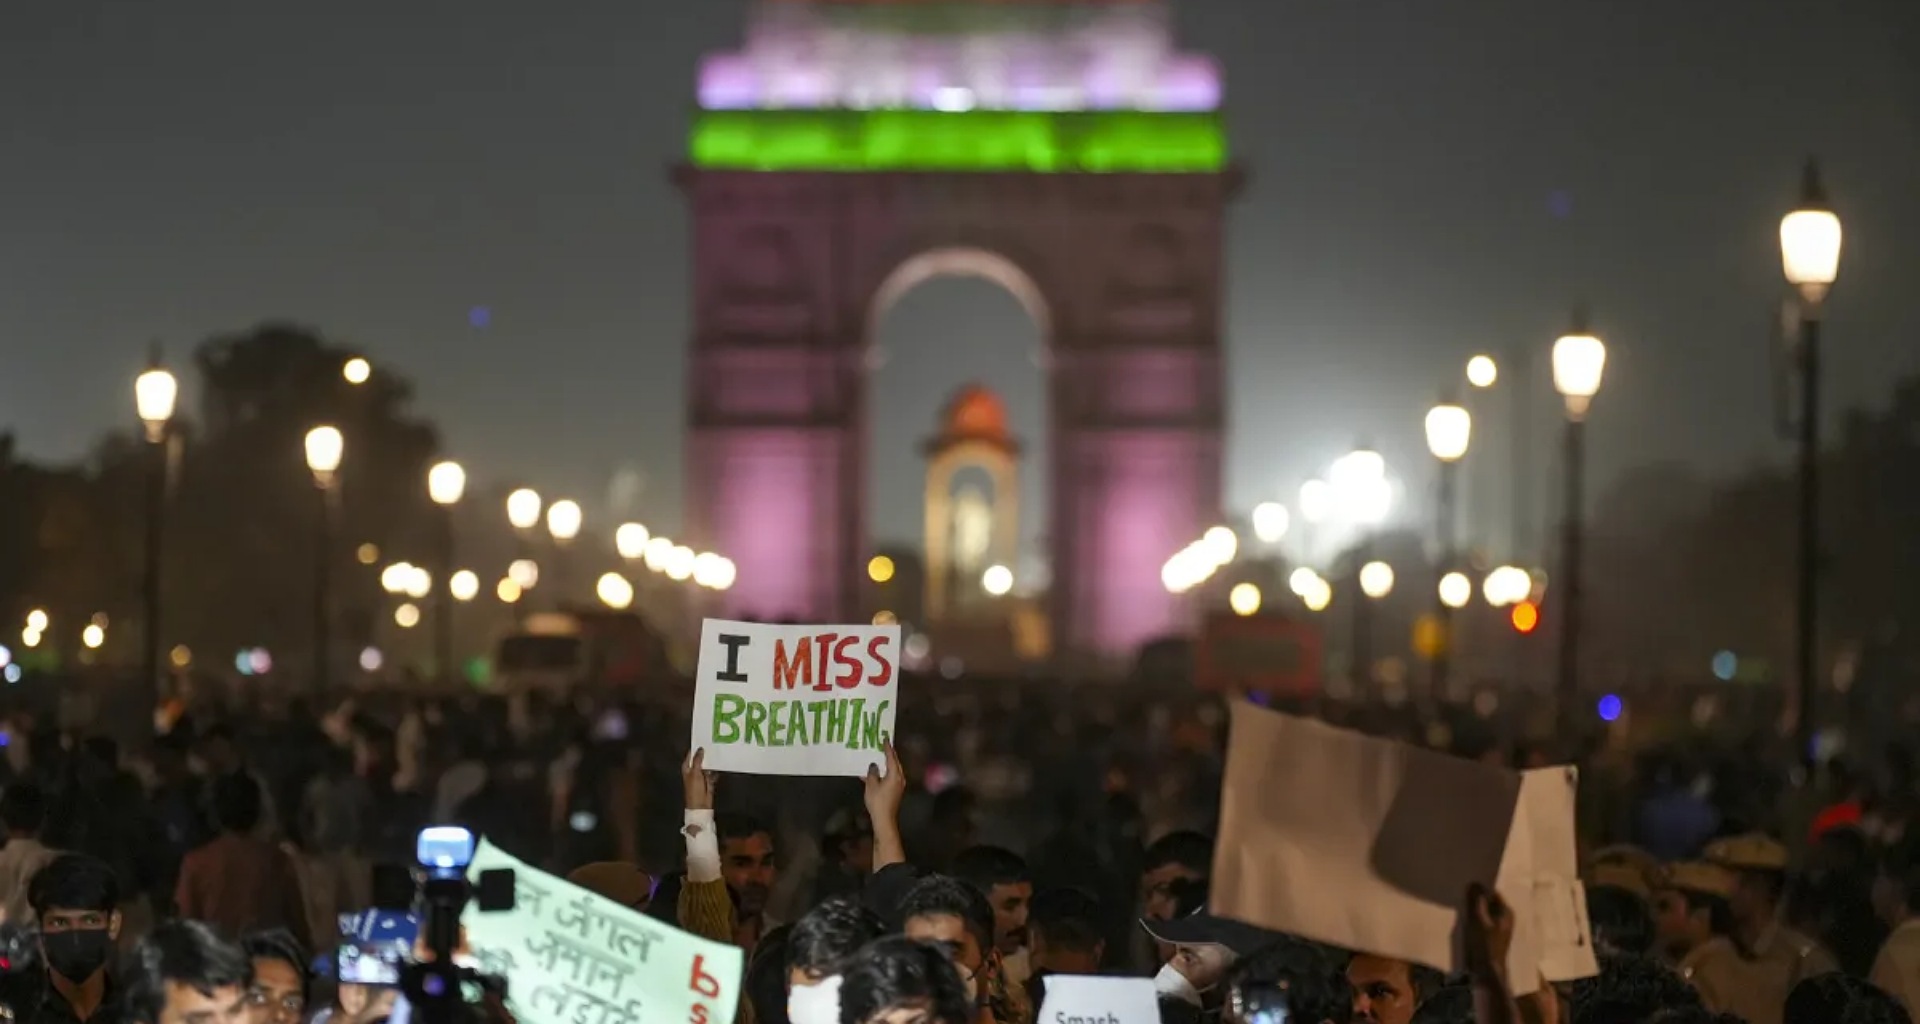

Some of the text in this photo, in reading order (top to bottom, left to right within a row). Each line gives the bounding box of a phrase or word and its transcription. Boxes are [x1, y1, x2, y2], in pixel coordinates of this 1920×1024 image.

[716, 632, 892, 691] I MISS
[711, 693, 890, 752] BREATHING
